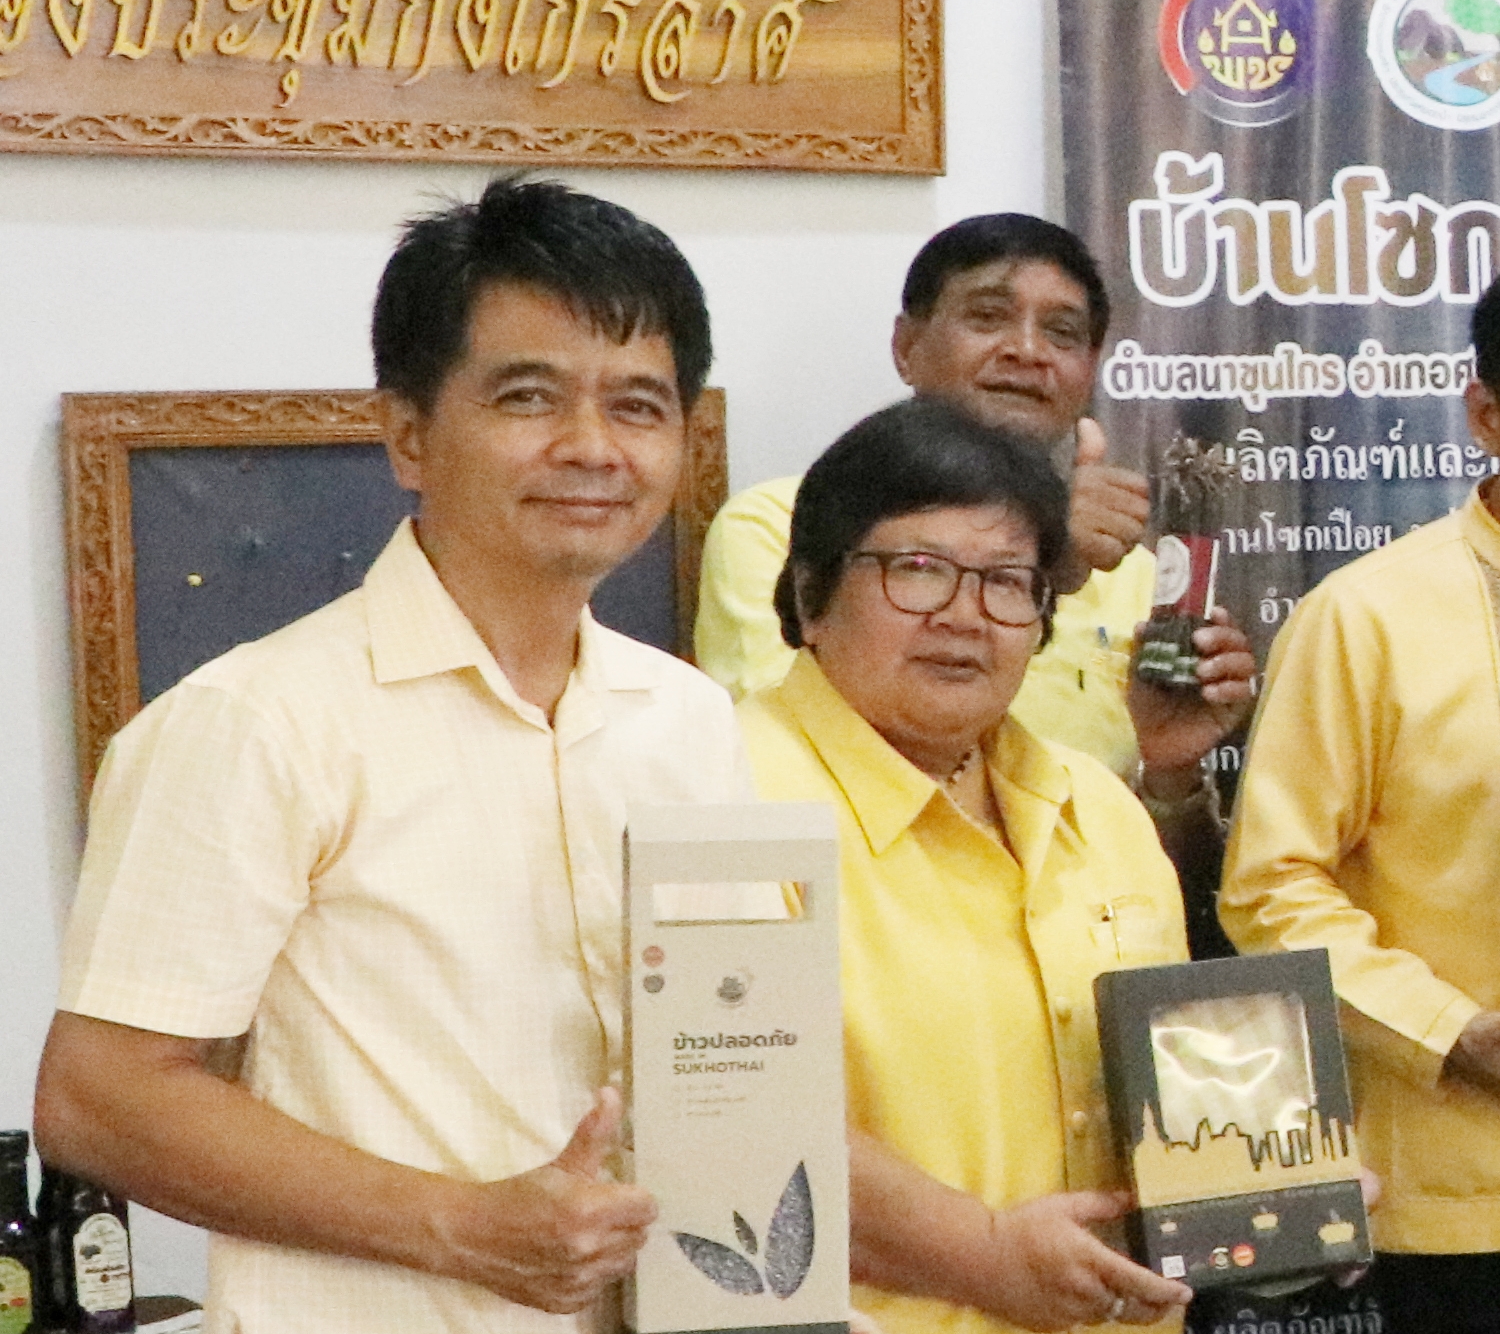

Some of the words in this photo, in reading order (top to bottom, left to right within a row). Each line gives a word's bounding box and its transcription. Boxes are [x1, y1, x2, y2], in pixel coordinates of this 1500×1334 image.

[1104, 339, 1346, 413] ตำบลนาขุนไกร
[1224, 418, 1500, 482] ลิตภัณฑ์และ
[672, 1028, 798, 1051] ข้าวปลอดภัย
[672, 1059, 765, 1075] SUKHOTHAI
